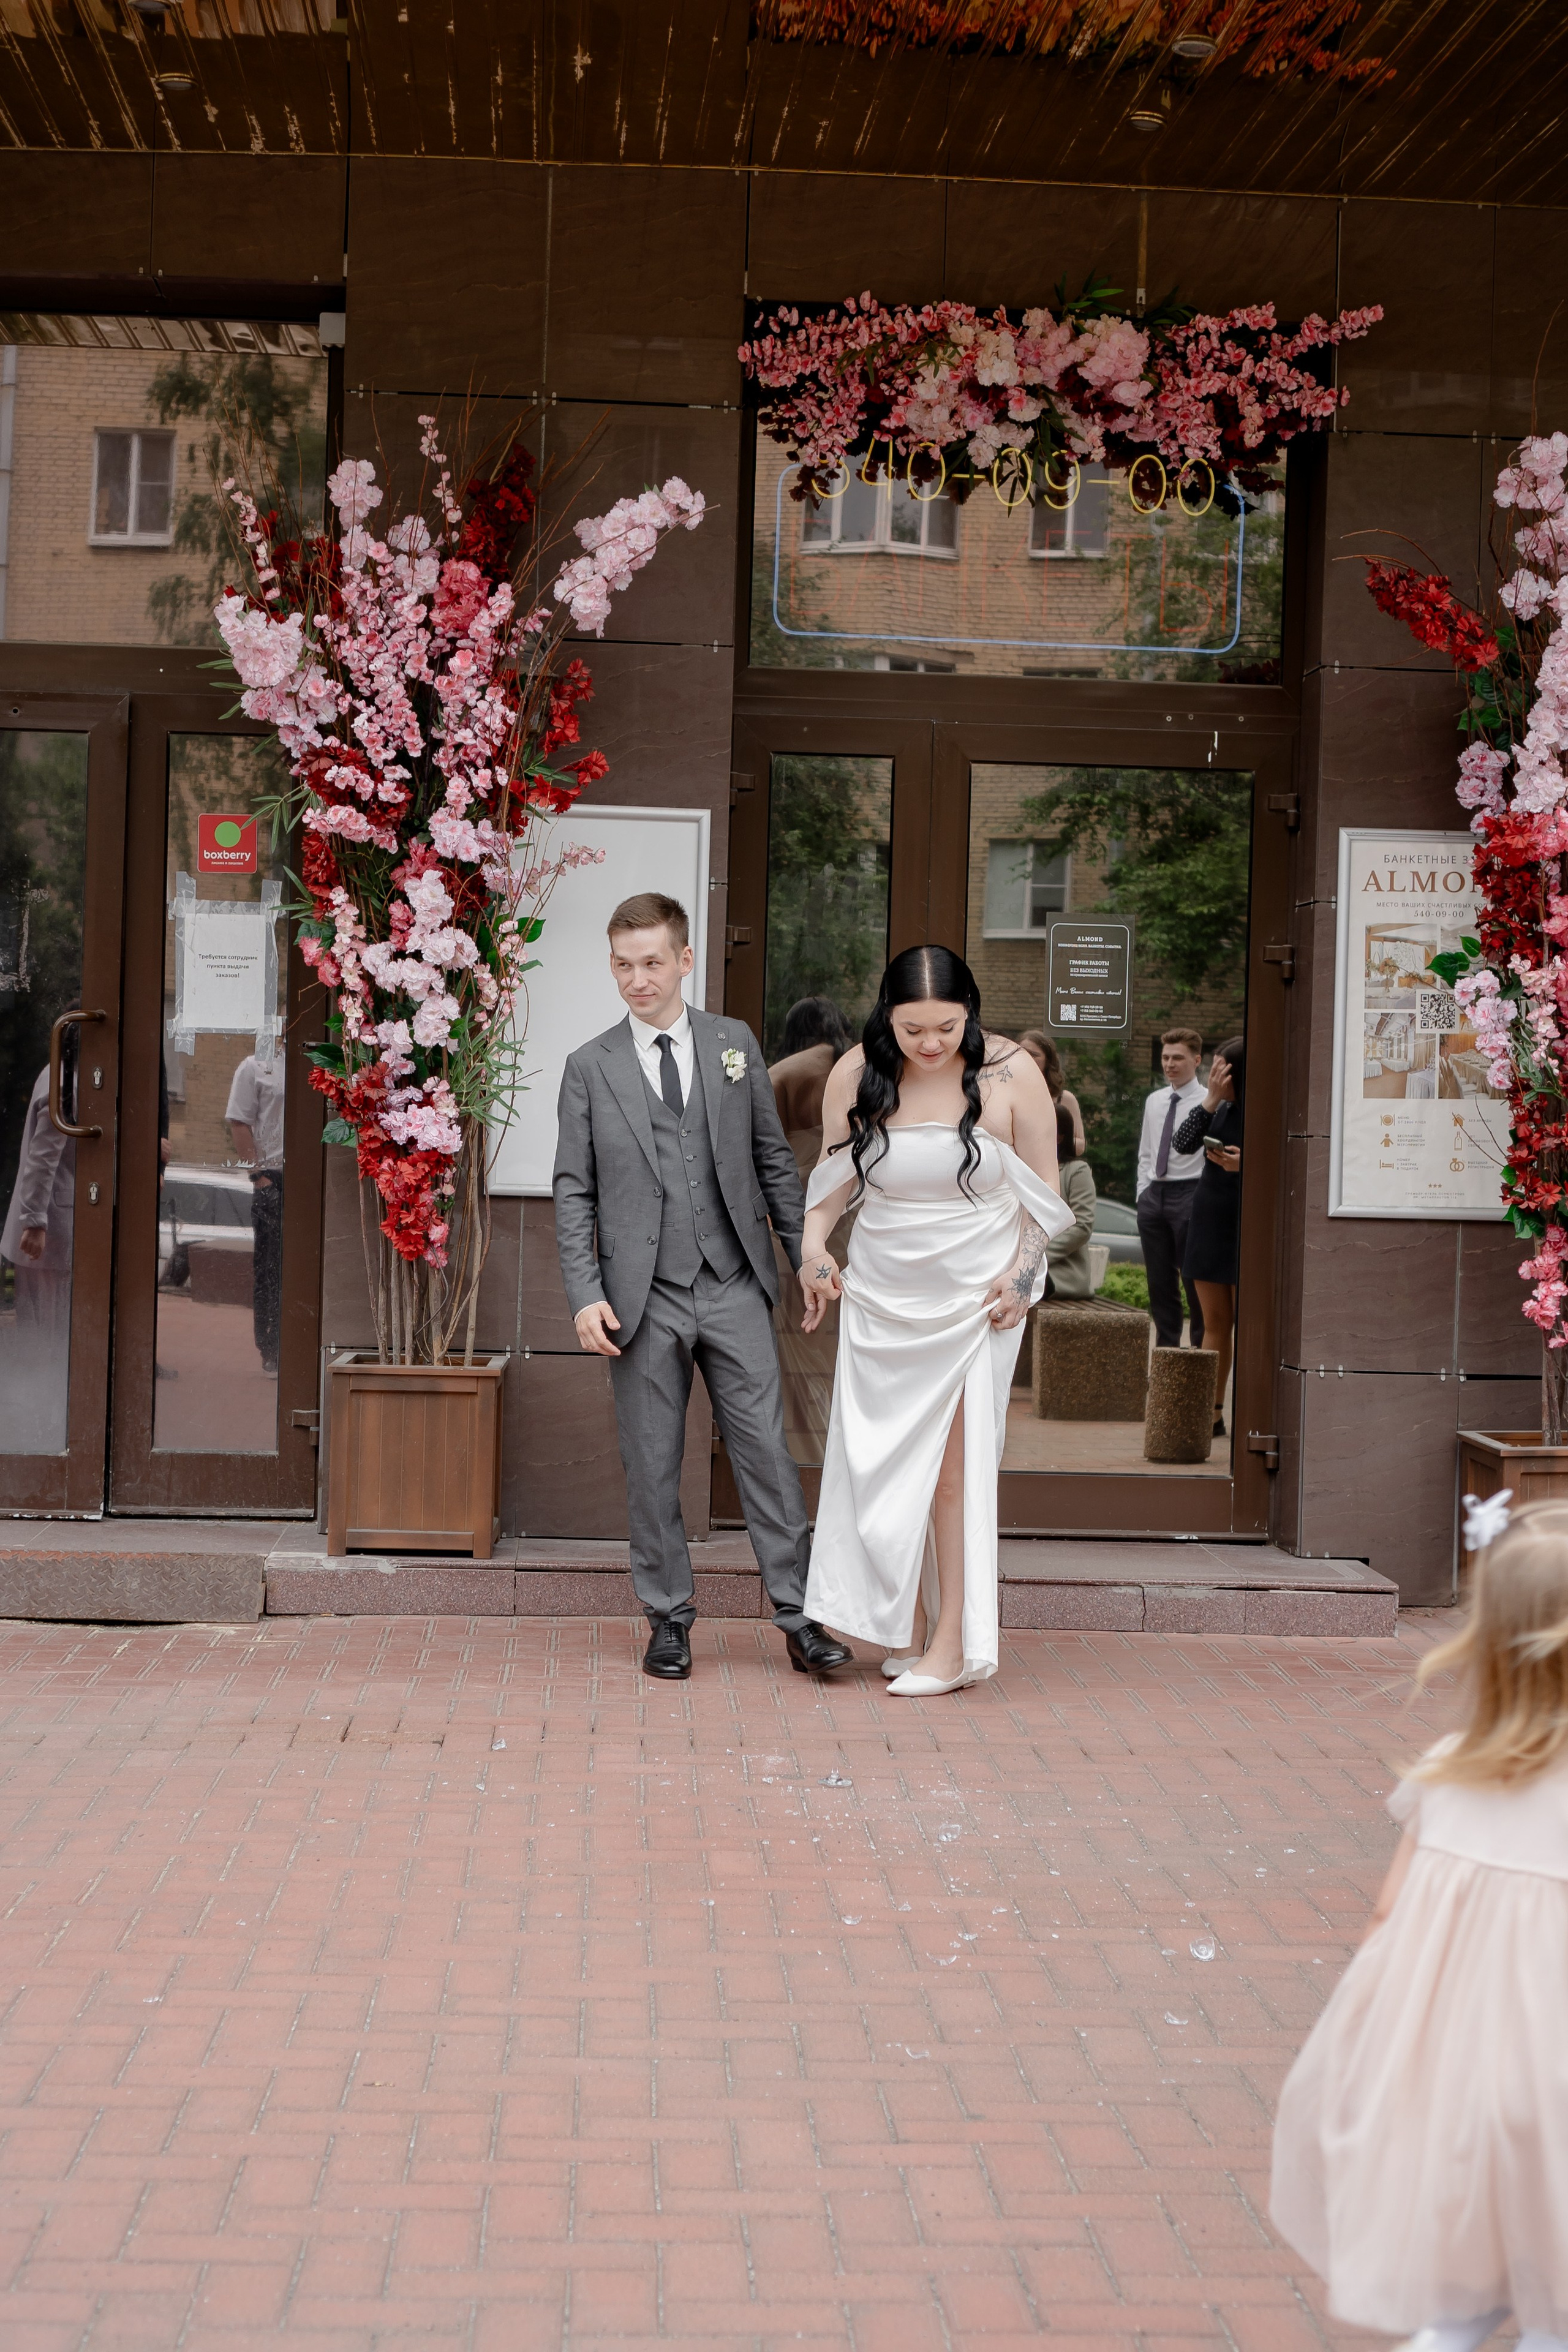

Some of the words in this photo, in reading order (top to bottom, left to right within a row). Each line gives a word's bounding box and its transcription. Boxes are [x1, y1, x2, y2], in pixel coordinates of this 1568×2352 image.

[790, 518, 1229, 633] БАНКЕТЫ
[203, 849, 251, 862] boxberry
[1384, 854, 1457, 864] БАНКЕТНЫЕ
[1361, 870, 1477, 893] ALMO
